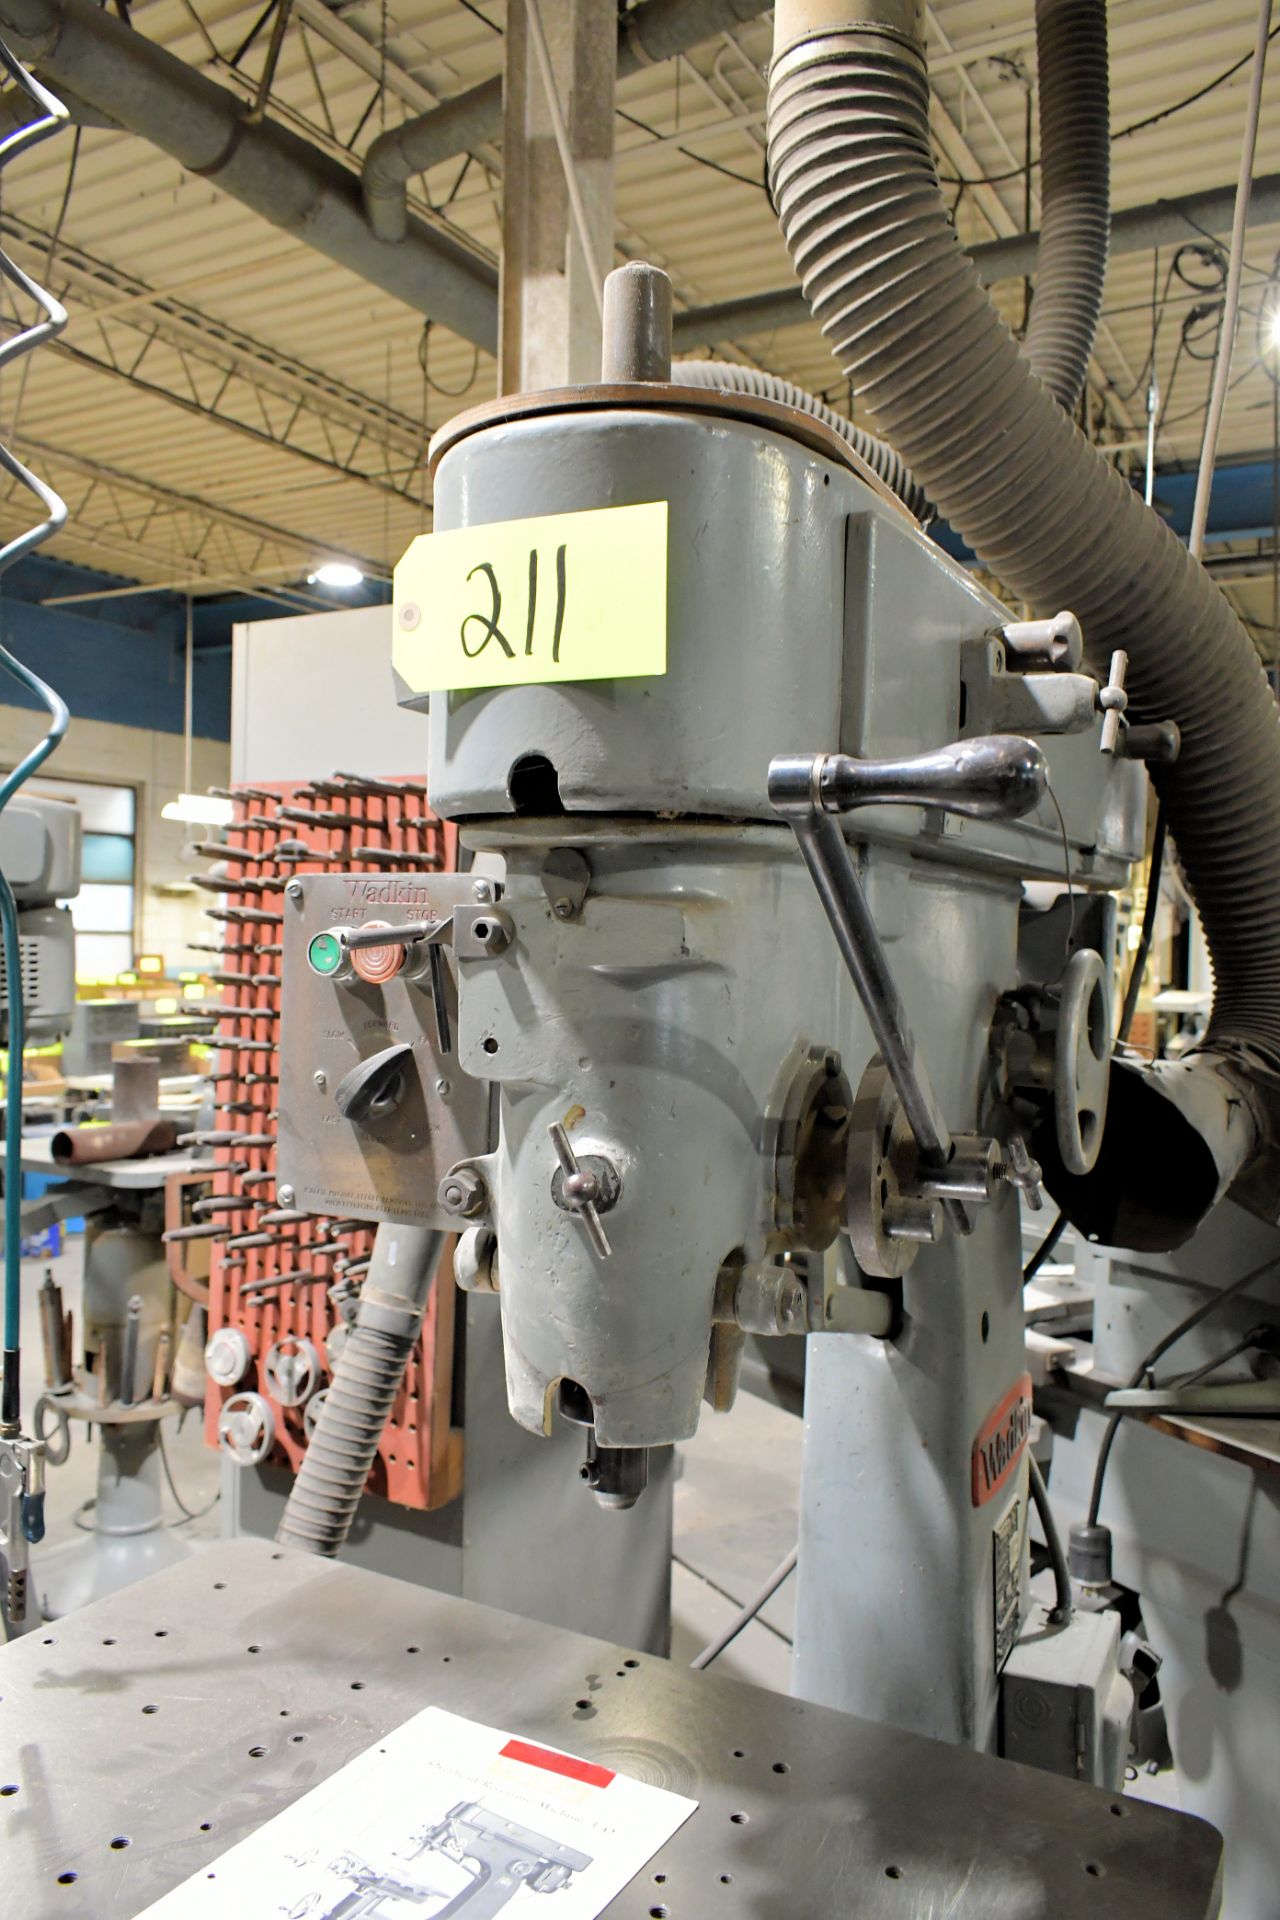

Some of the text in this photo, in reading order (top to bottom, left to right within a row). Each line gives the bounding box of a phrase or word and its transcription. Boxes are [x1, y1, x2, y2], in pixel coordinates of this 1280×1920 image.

[461, 544, 567, 663] 211
[343, 878, 430, 905] Wadkin
[406, 908, 437, 921] STOP
